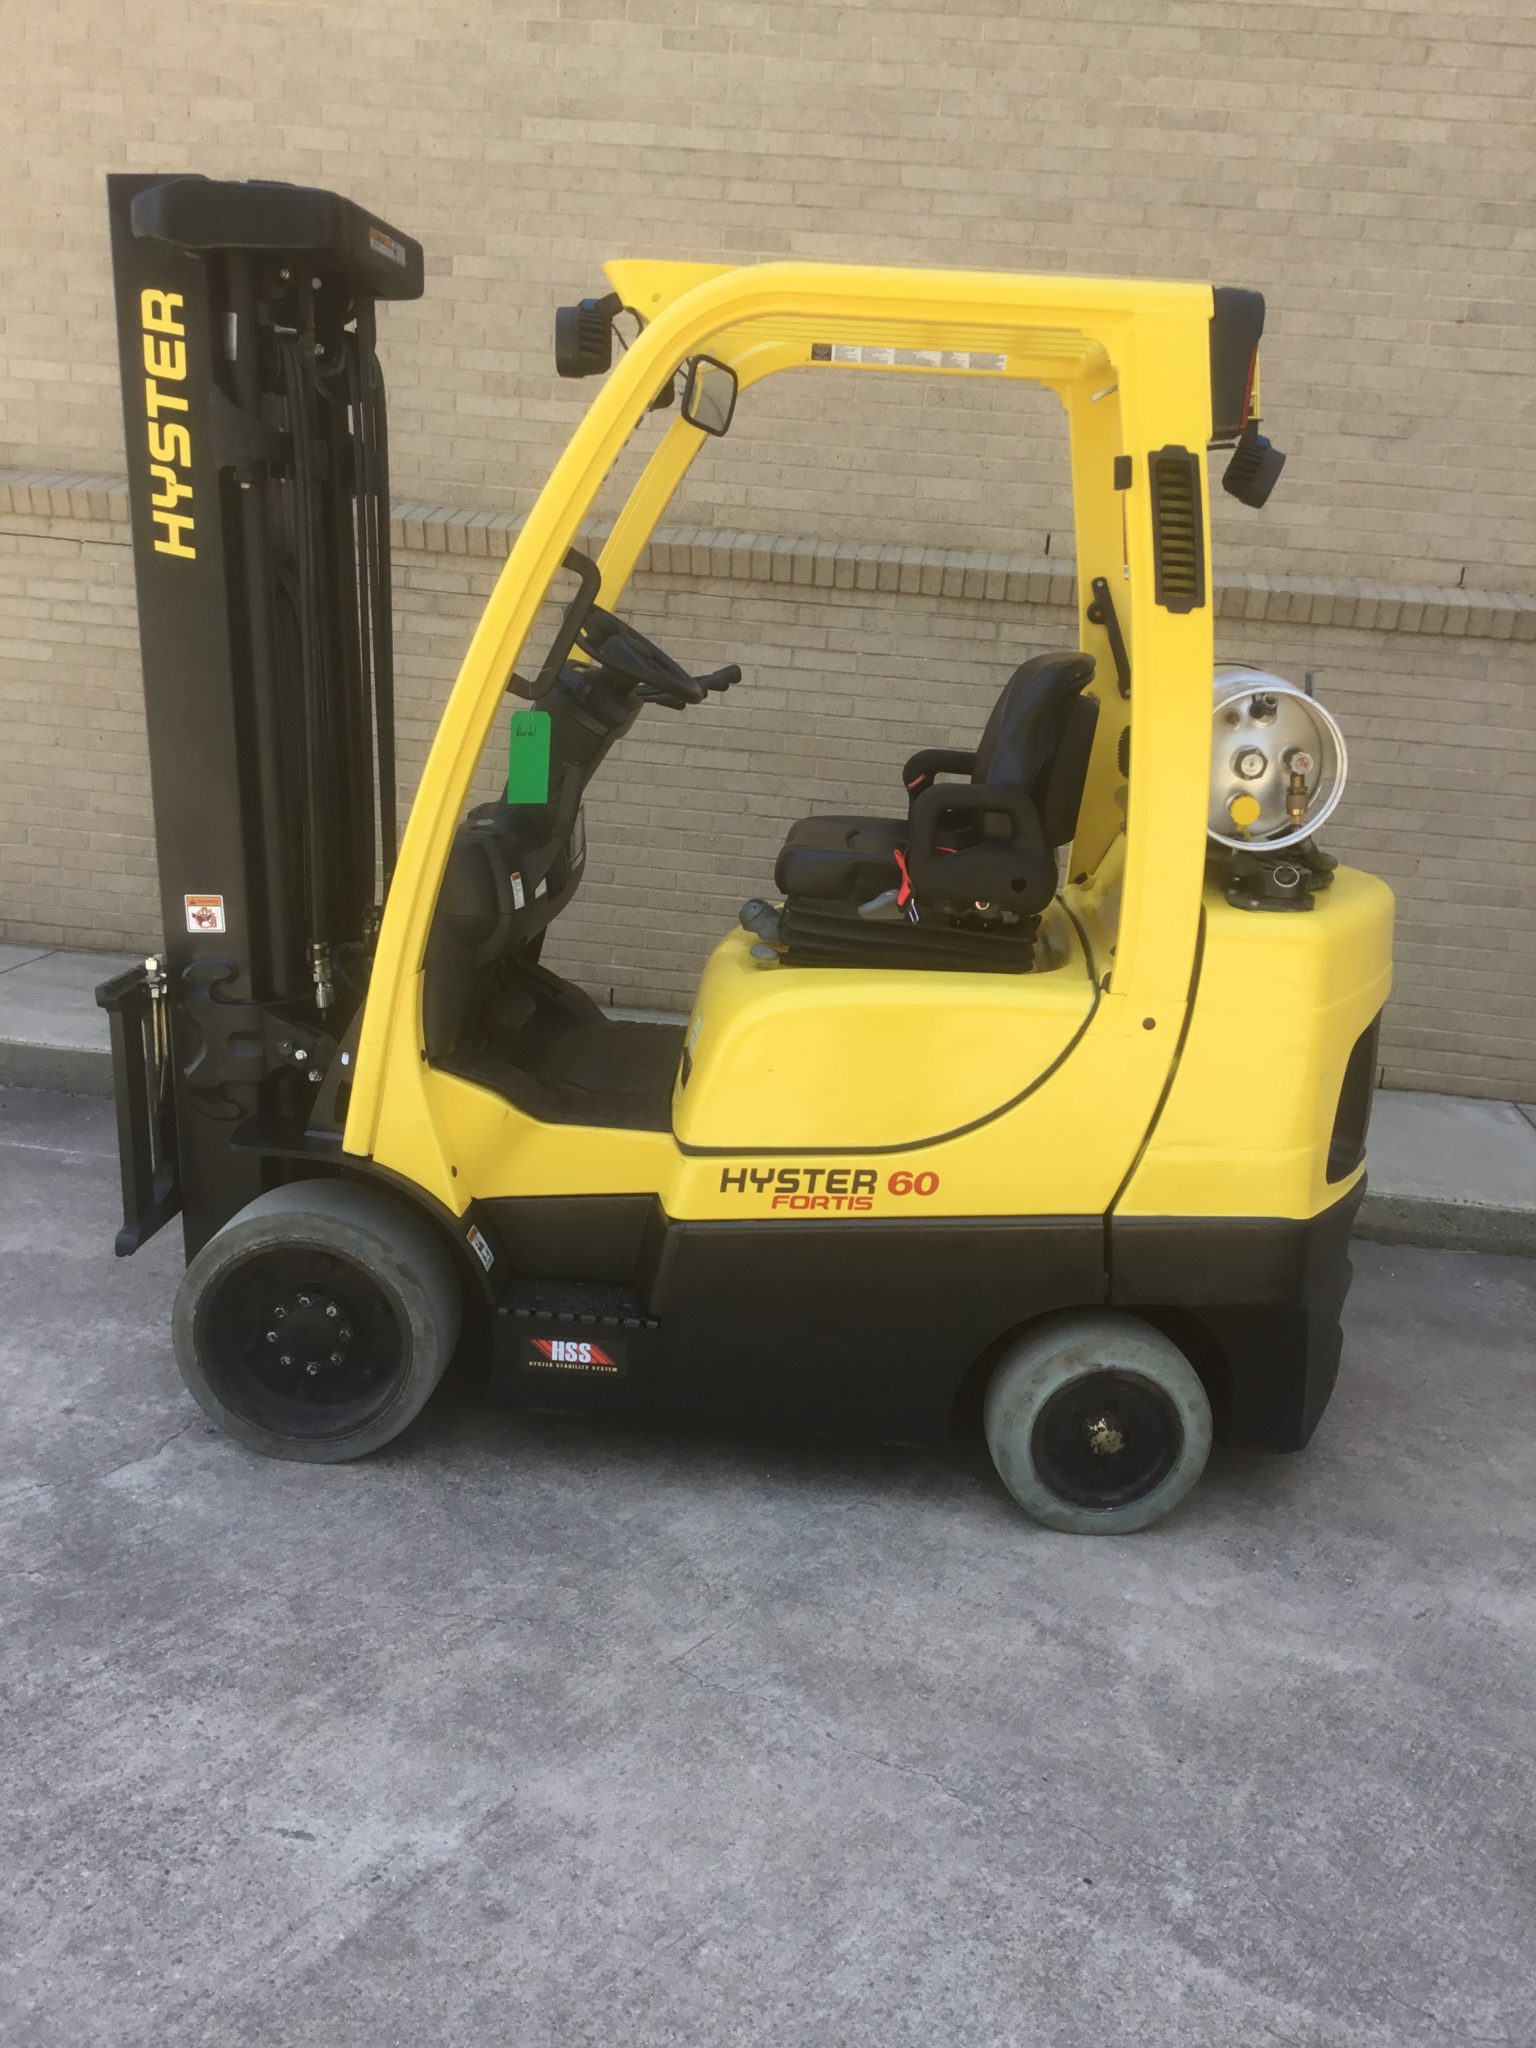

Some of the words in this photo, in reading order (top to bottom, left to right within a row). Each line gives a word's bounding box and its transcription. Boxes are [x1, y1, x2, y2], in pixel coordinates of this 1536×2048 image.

[141, 288, 196, 559] HYSTER
[719, 1167, 878, 1195] HYSTER
[887, 1170, 940, 1196] 60
[771, 1195, 873, 1211] FORTIS
[551, 1340, 591, 1363] HSS
